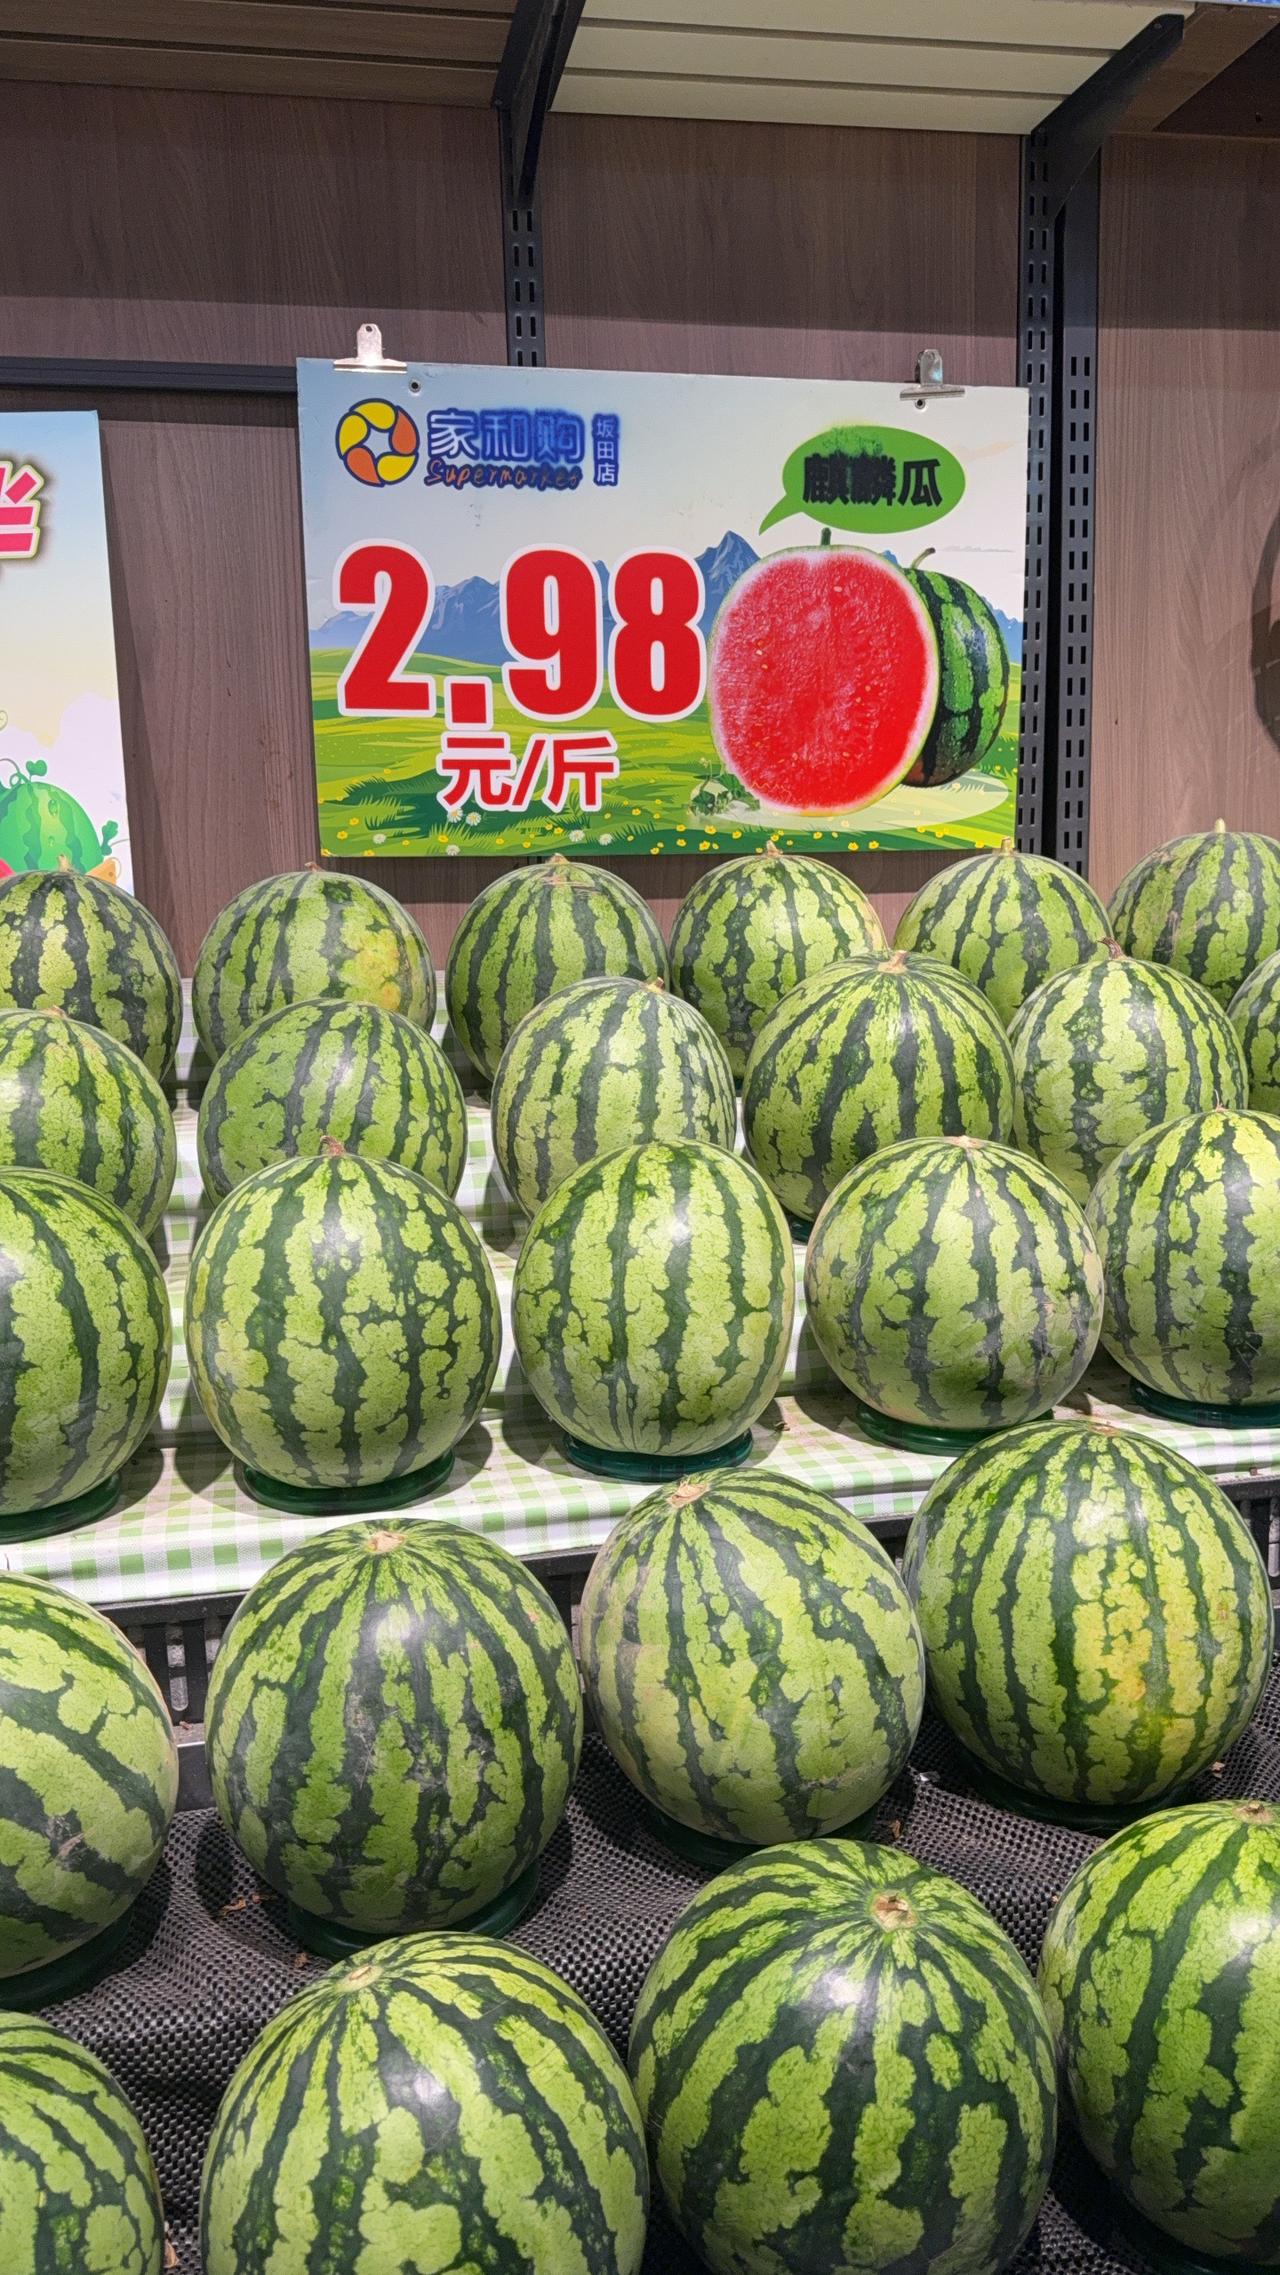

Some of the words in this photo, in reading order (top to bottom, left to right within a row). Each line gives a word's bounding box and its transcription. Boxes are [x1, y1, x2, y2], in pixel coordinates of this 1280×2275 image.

[429, 410, 584, 462] 家和购
[594, 415, 618, 485] 坂田店
[803, 450, 943, 507] 麒麟瓜
[337, 542, 704, 727] 2.98
[439, 733, 617, 810] 元/斤
